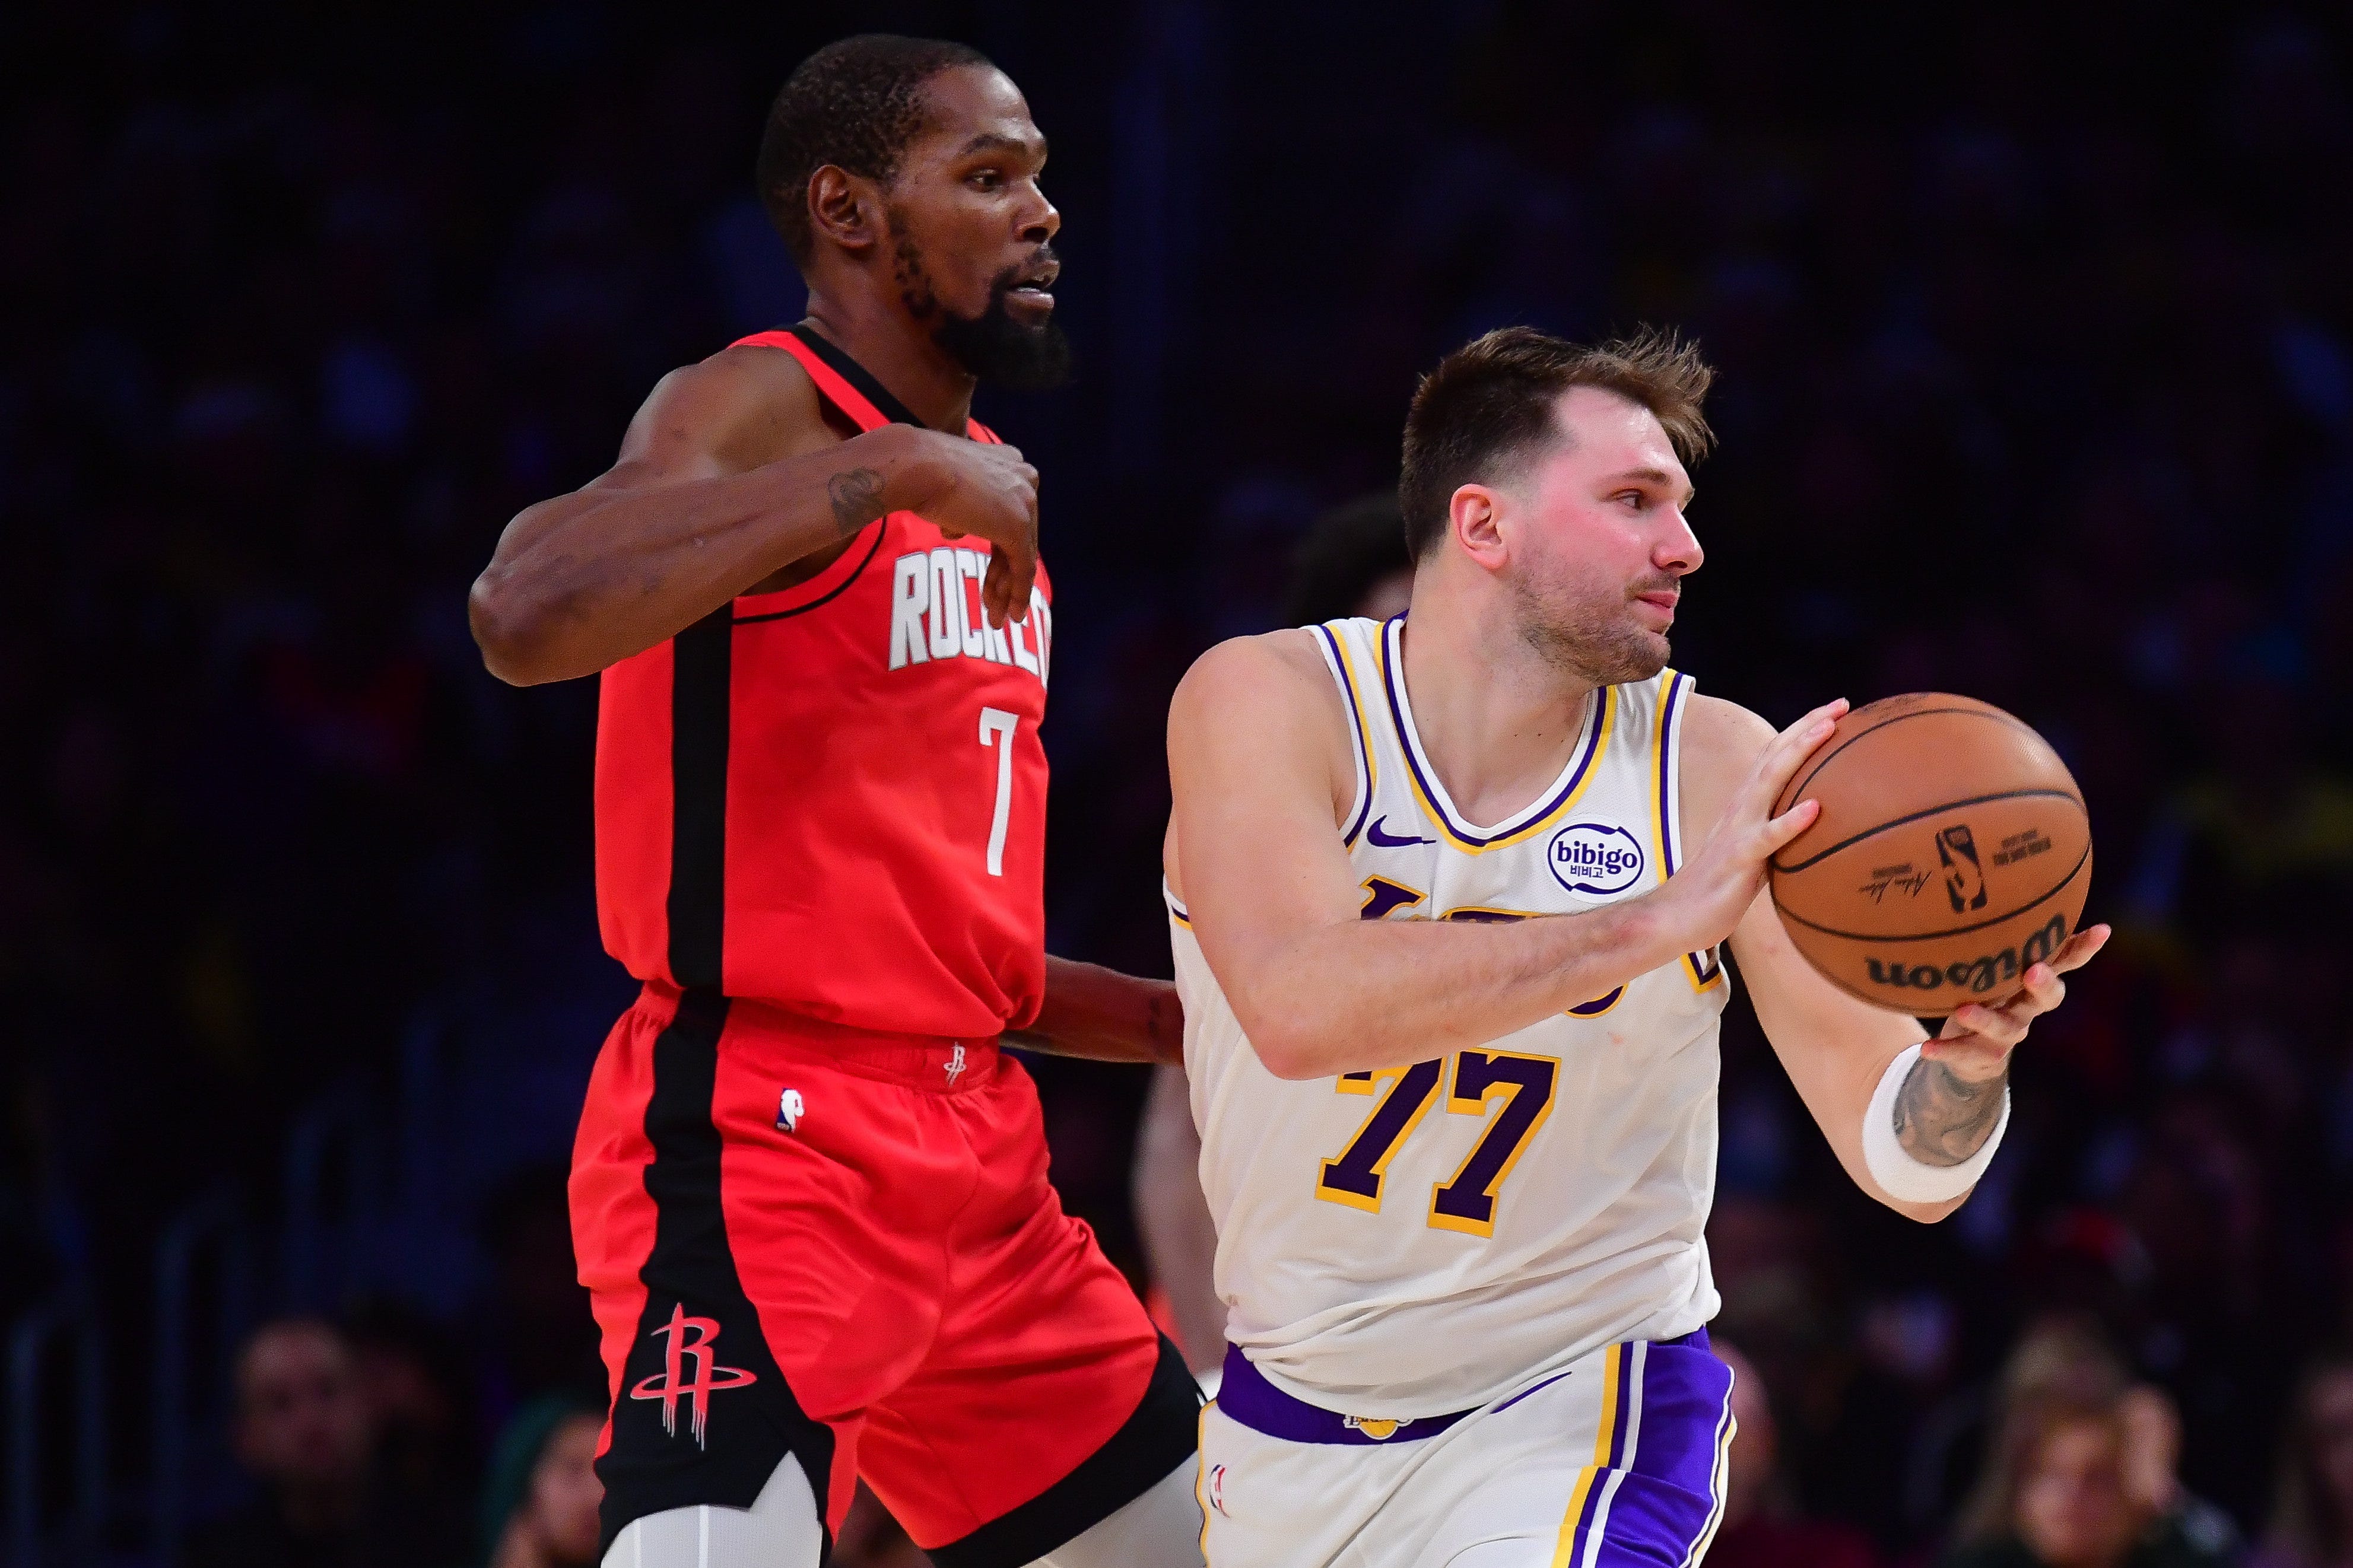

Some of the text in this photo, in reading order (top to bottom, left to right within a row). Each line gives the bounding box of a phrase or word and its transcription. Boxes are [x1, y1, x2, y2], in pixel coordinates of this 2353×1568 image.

[979, 707, 1019, 876] 7
[1557, 841, 1638, 874] bibigo
[1570, 865, 1604, 878] 비비고
[1864, 914, 2066, 993] Wilson
[1314, 1047, 1561, 1238] 77
